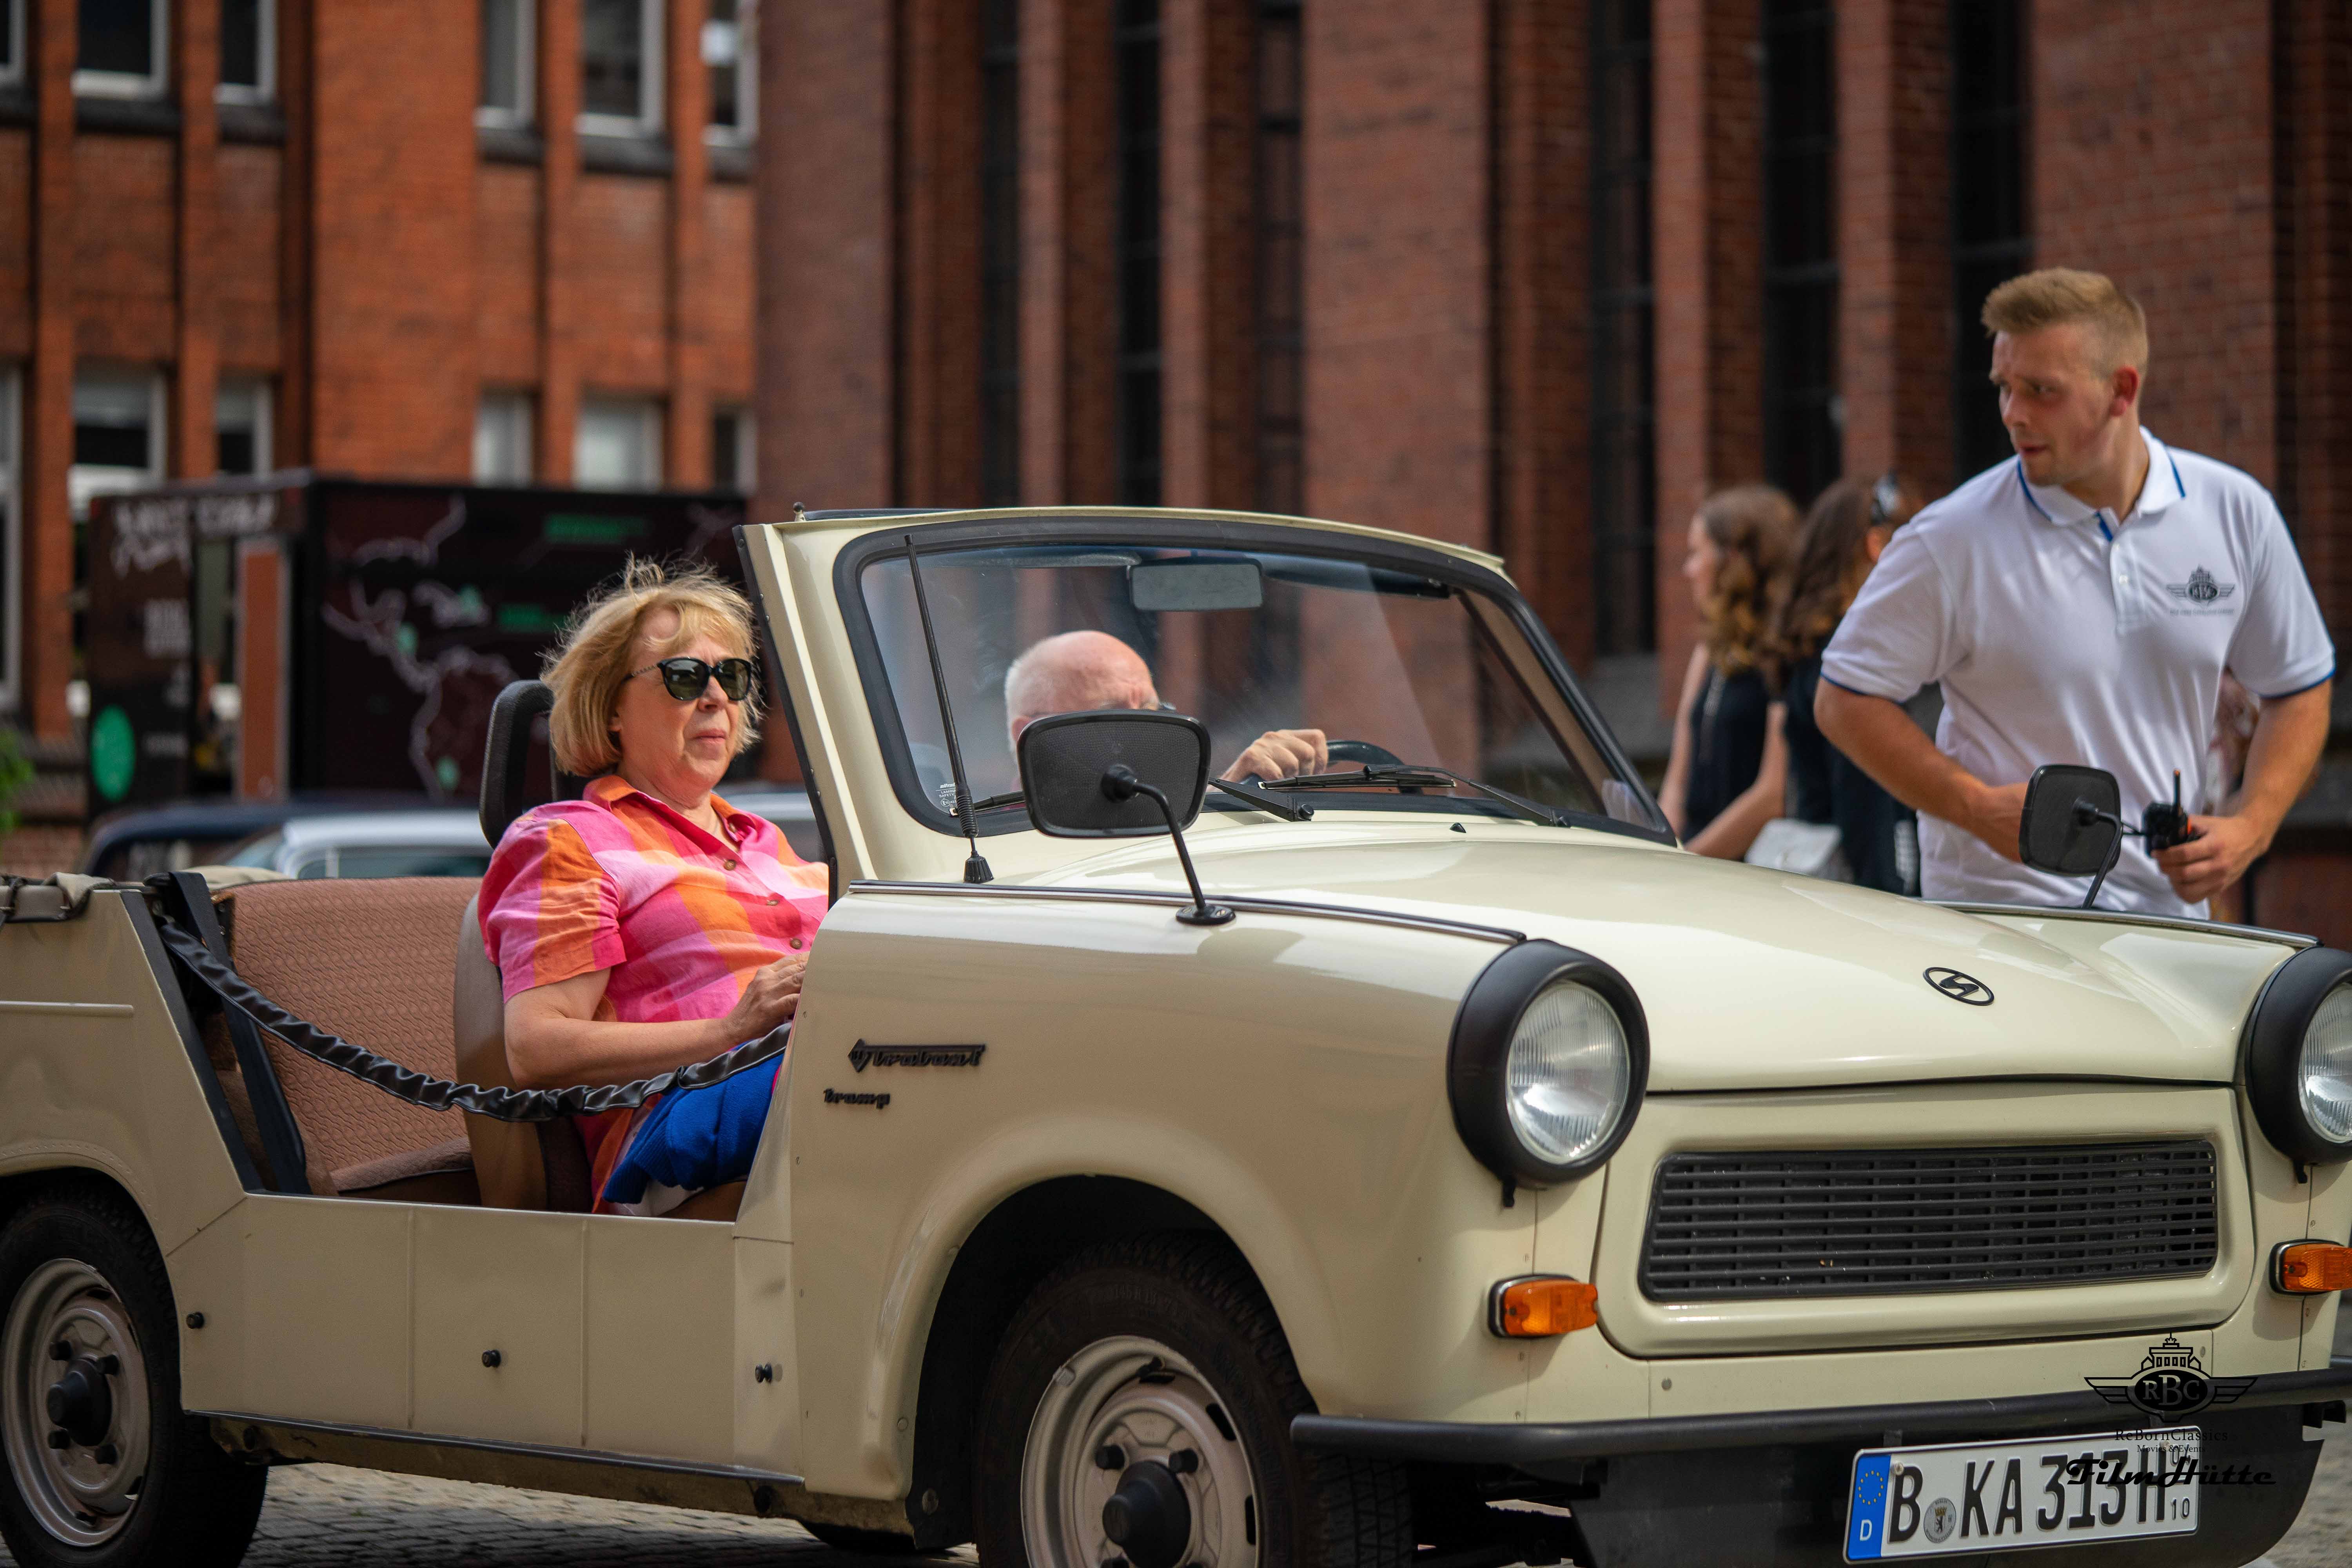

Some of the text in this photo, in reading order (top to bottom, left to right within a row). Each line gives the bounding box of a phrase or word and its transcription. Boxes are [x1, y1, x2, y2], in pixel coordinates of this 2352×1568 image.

[1887, 1465, 1923, 1544] B
[1960, 1457, 2023, 1537] KA
[2171, 1496, 2190, 1520] 10
[1859, 1519, 1872, 1541] D
